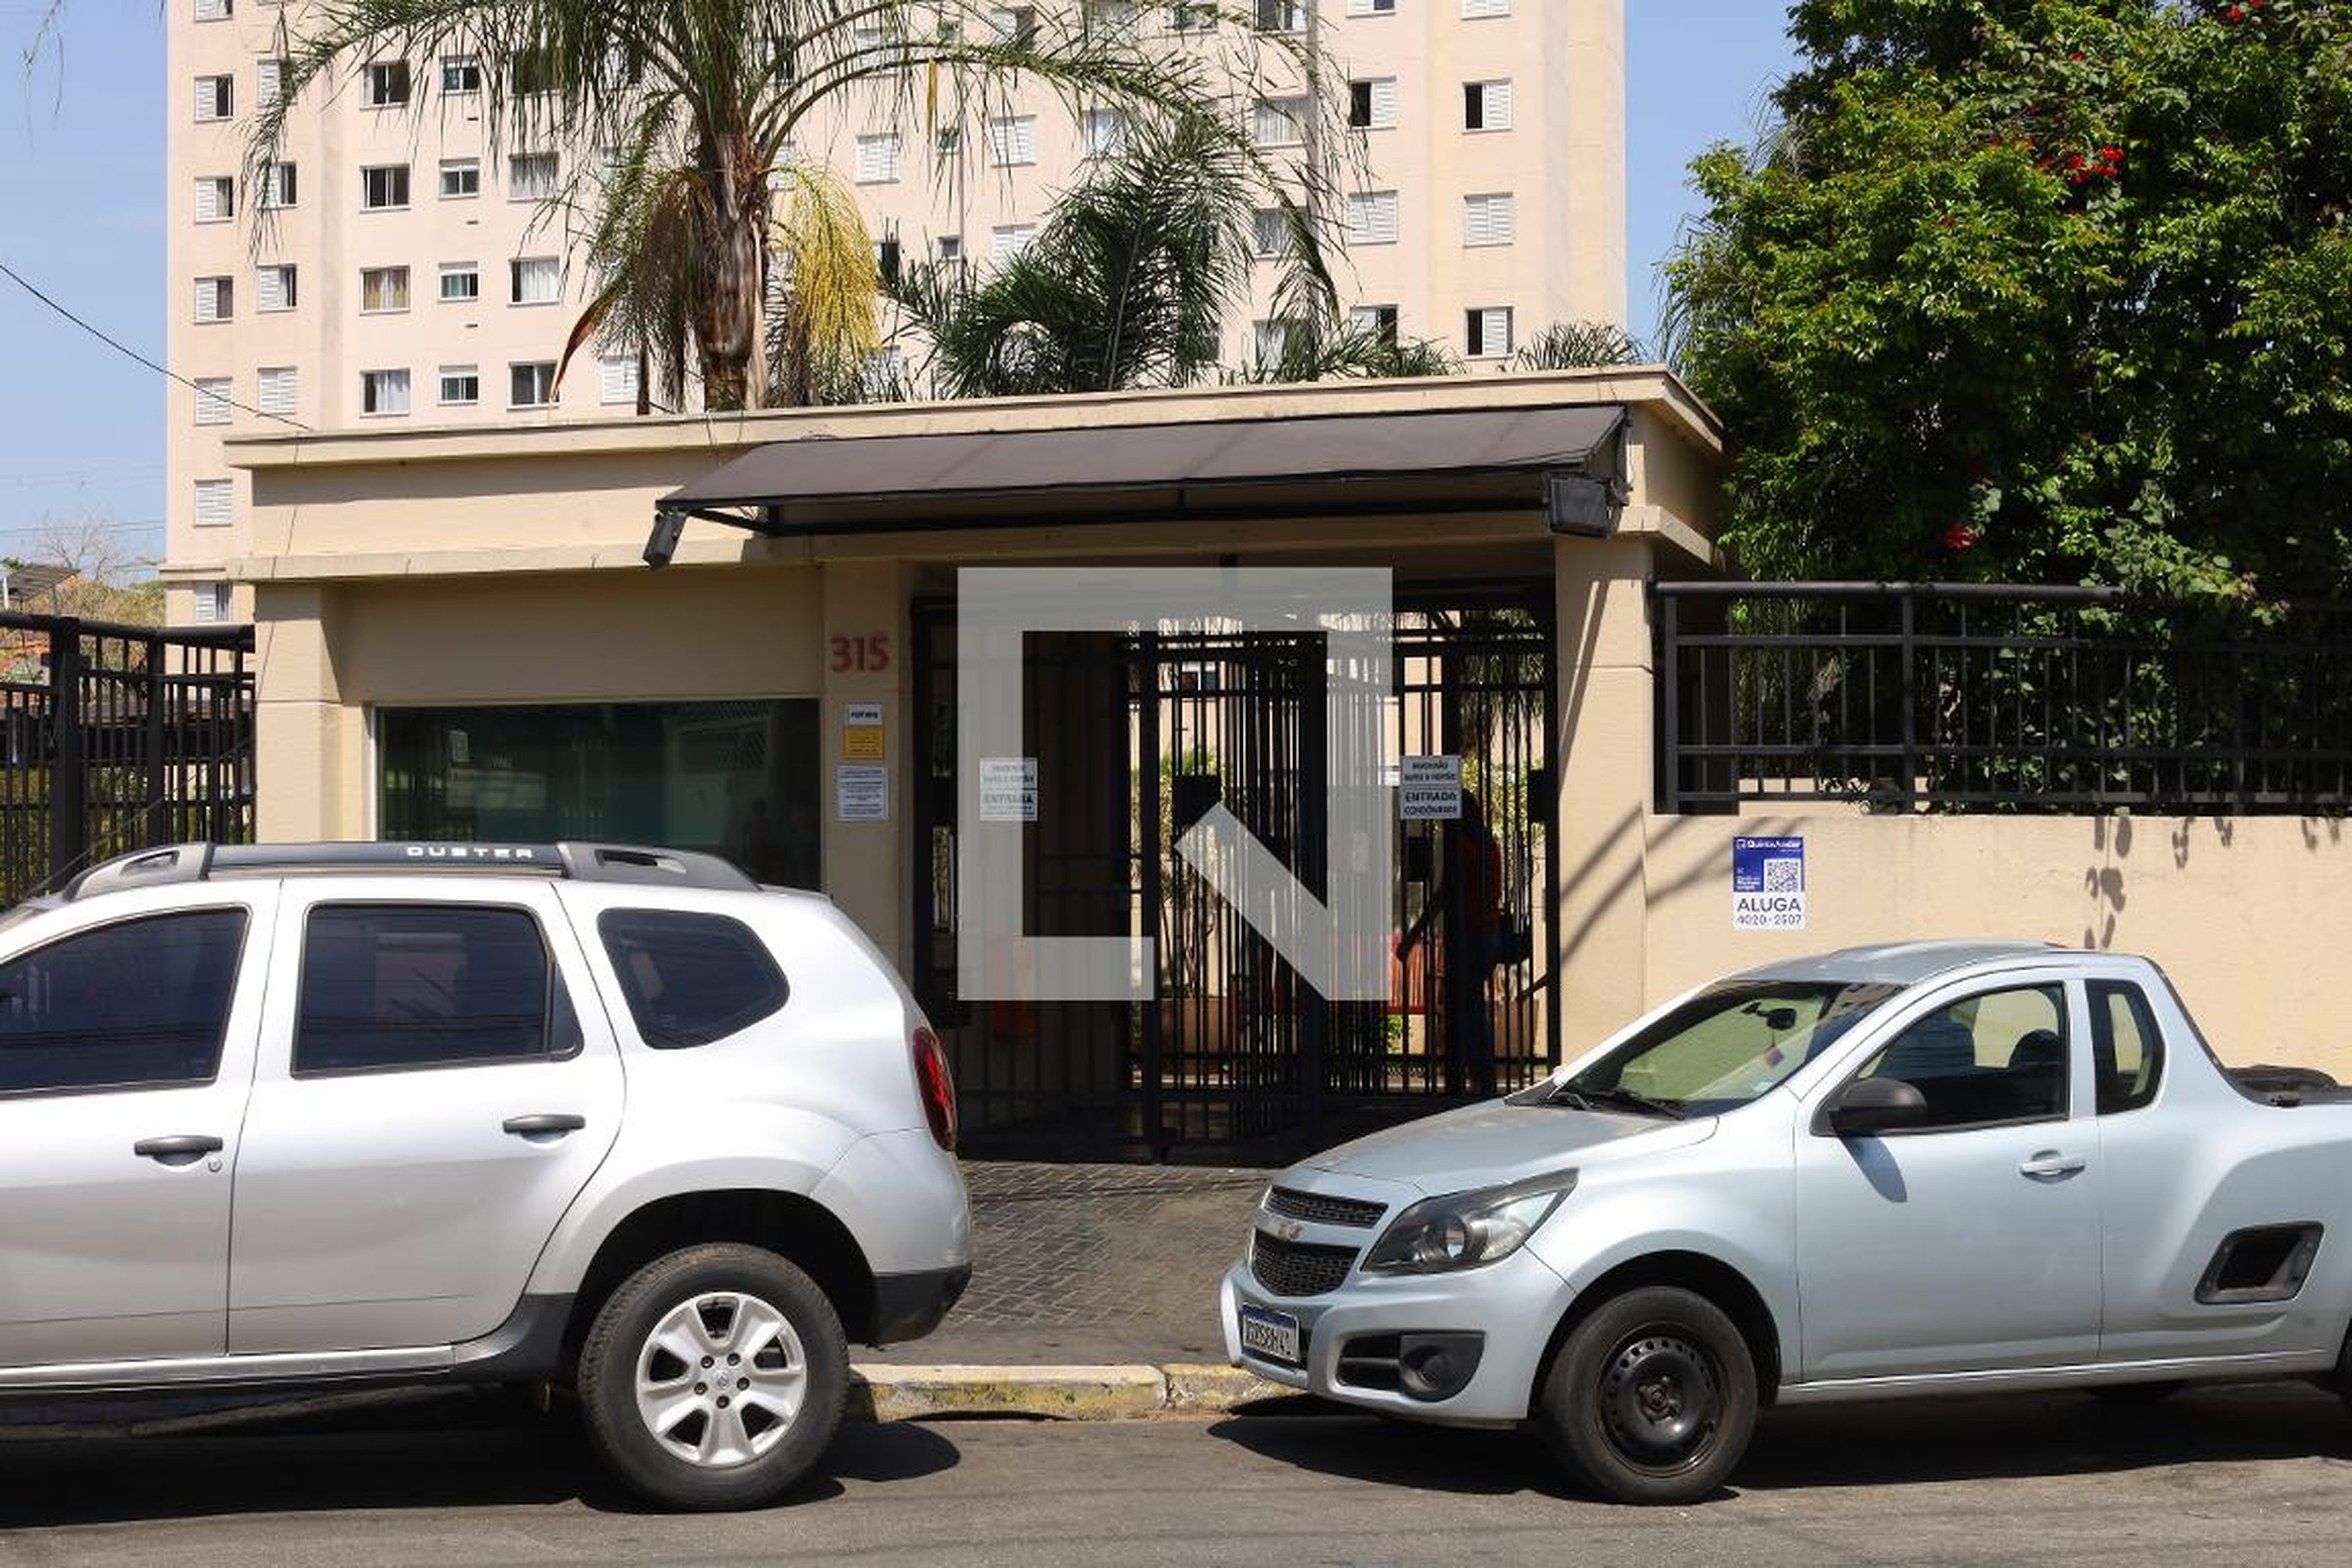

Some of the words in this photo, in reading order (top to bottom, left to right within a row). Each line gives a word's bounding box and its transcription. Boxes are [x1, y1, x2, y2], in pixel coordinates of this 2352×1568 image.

[830, 636, 891, 673] 315
[1406, 791, 1457, 802] ENTRADA
[407, 846, 533, 858] DUSTER
[1737, 898, 1801, 912] ALUGA
